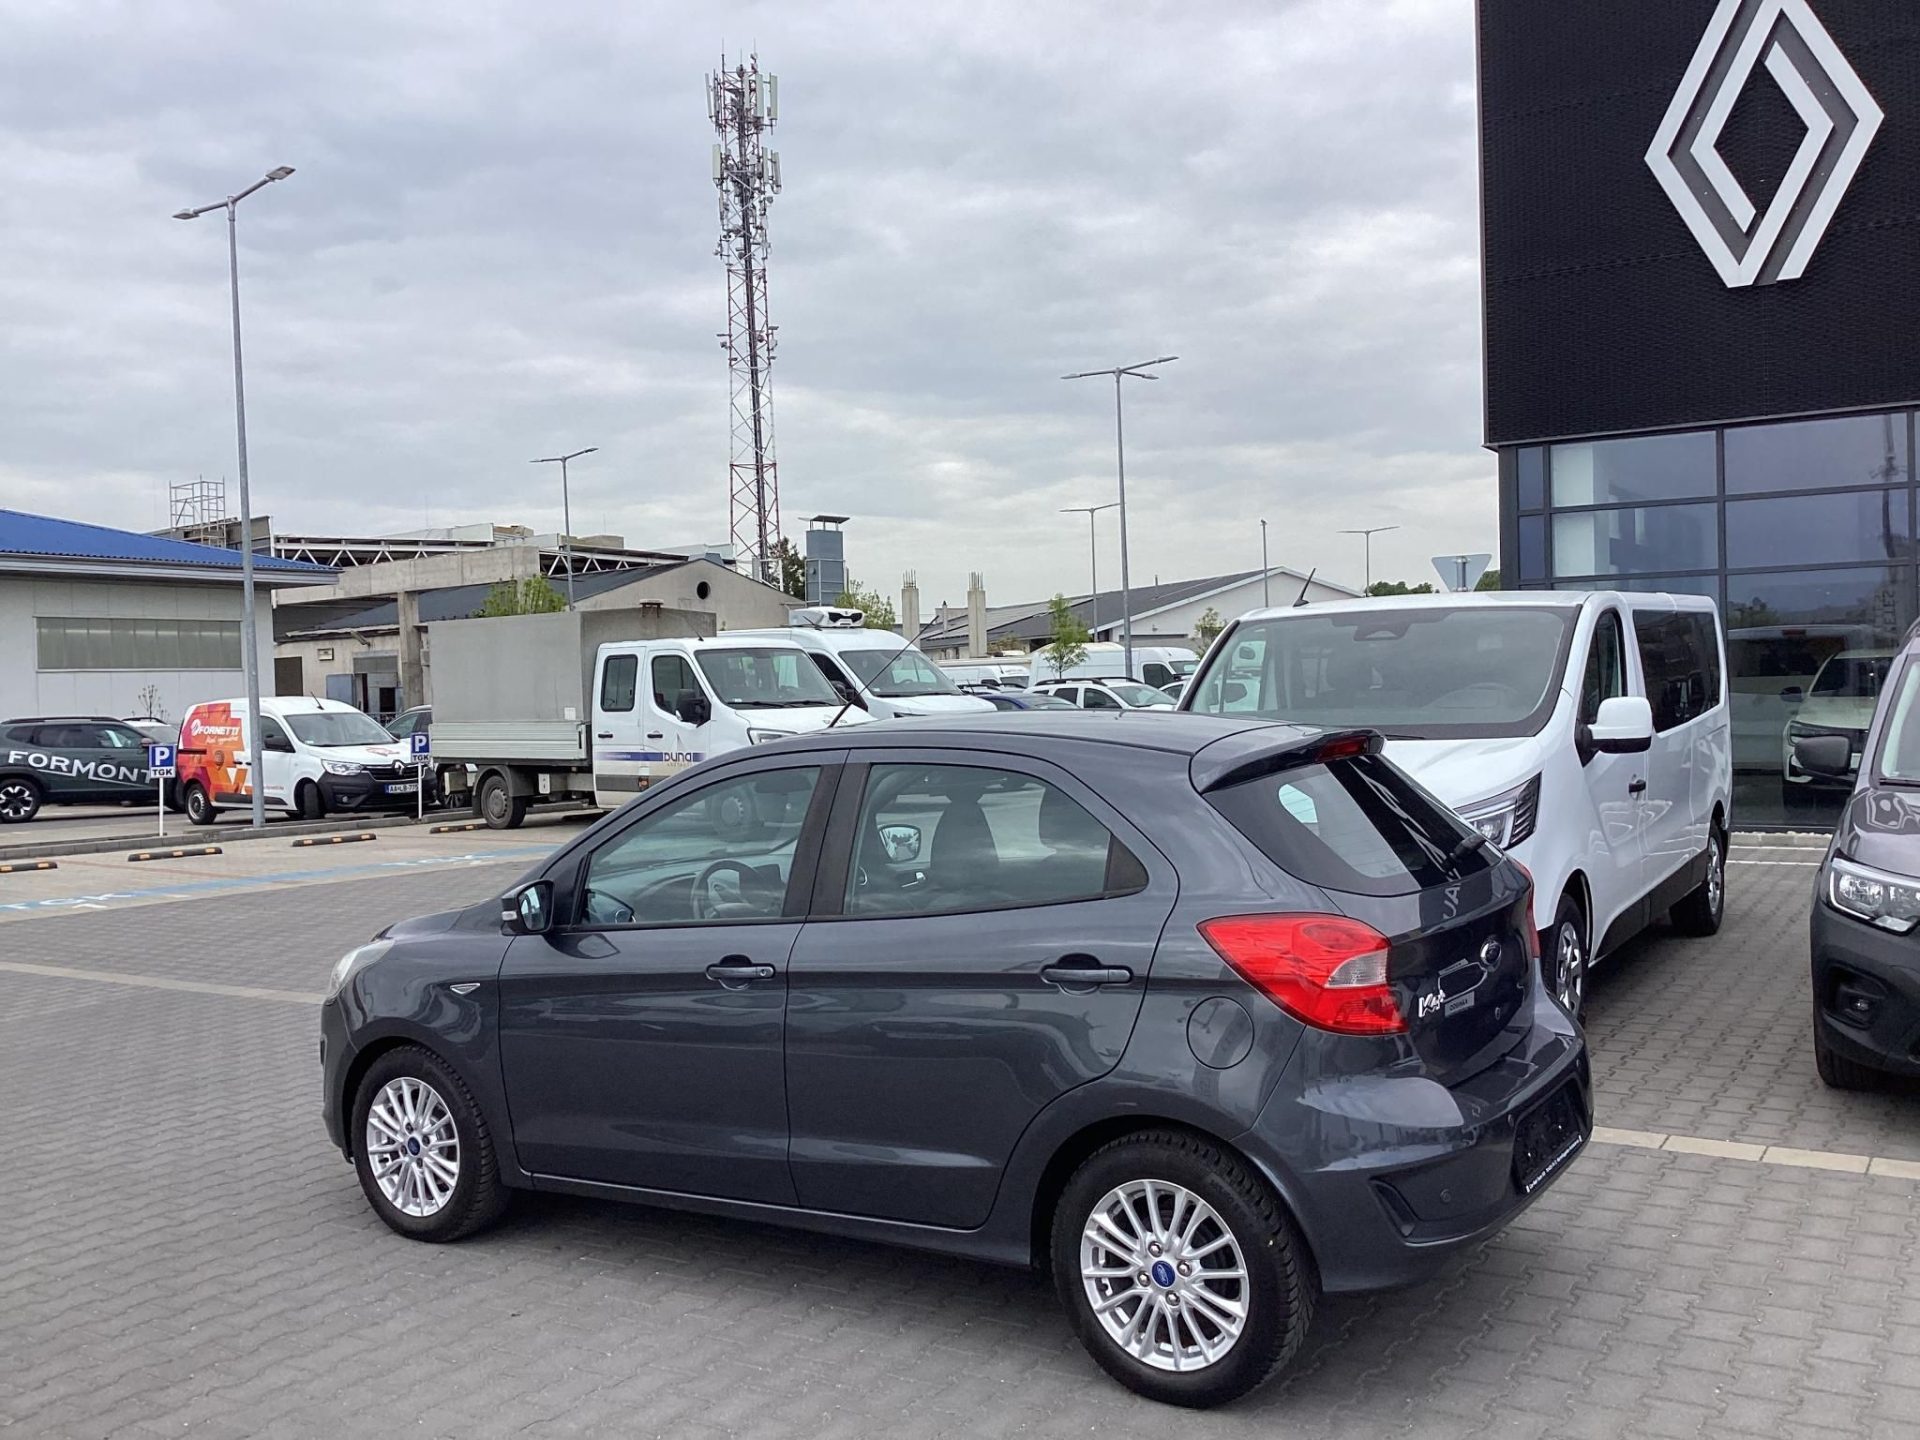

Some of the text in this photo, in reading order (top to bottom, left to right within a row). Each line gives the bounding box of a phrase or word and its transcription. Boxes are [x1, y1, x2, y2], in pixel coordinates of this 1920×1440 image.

[198, 725, 241, 736] FORNETTI
[414, 735, 427, 752] P
[154, 746, 170, 766] P
[151, 768, 172, 776] TGK
